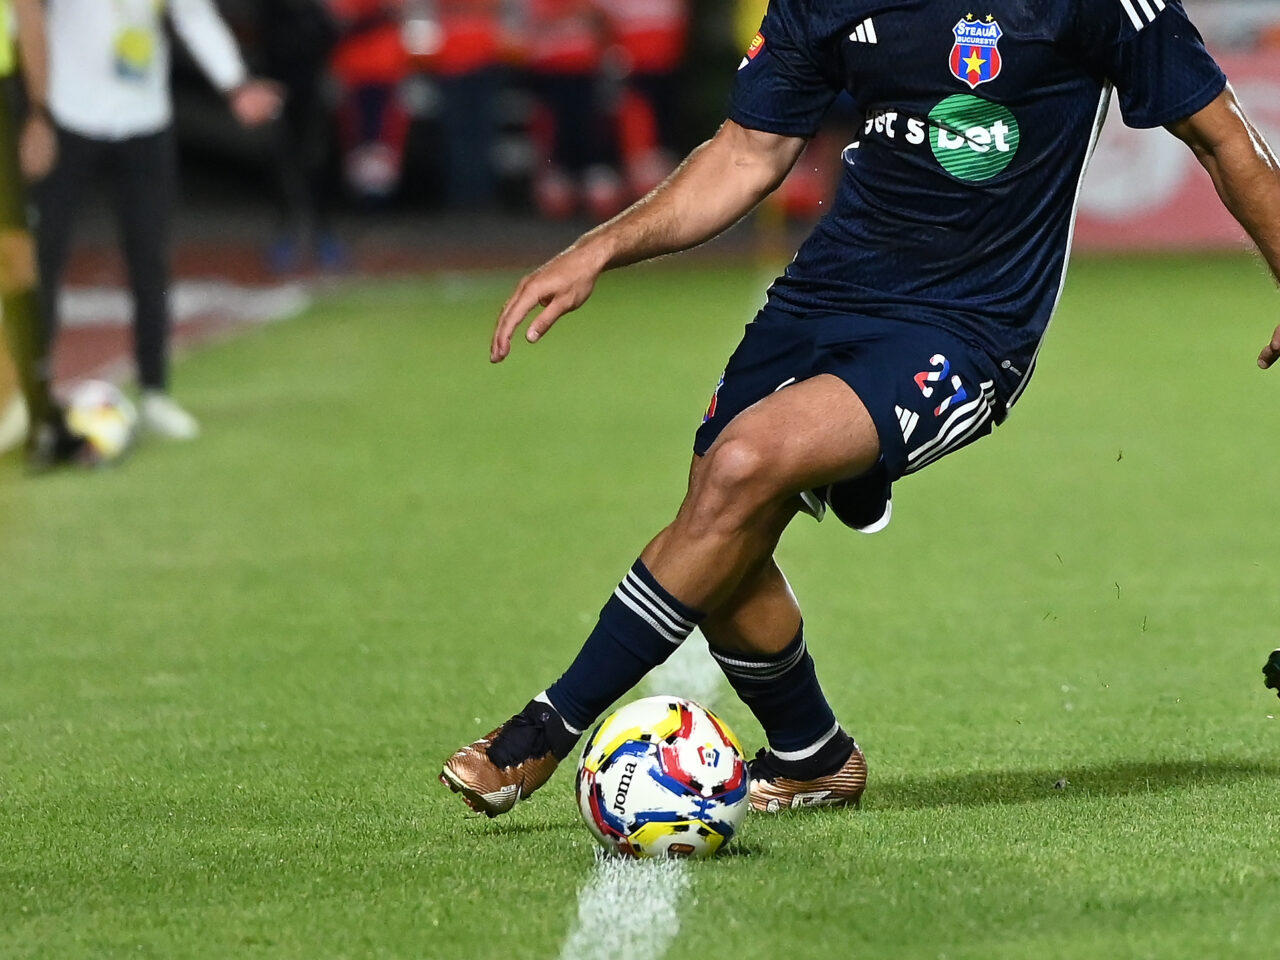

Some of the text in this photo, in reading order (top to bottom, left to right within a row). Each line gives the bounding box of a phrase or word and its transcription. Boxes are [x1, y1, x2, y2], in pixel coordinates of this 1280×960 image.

[957, 22, 998, 37] STEAUA
[957, 36, 996, 46] BUCURESTI
[937, 118, 1010, 153] bet
[613, 761, 637, 815] Joma
